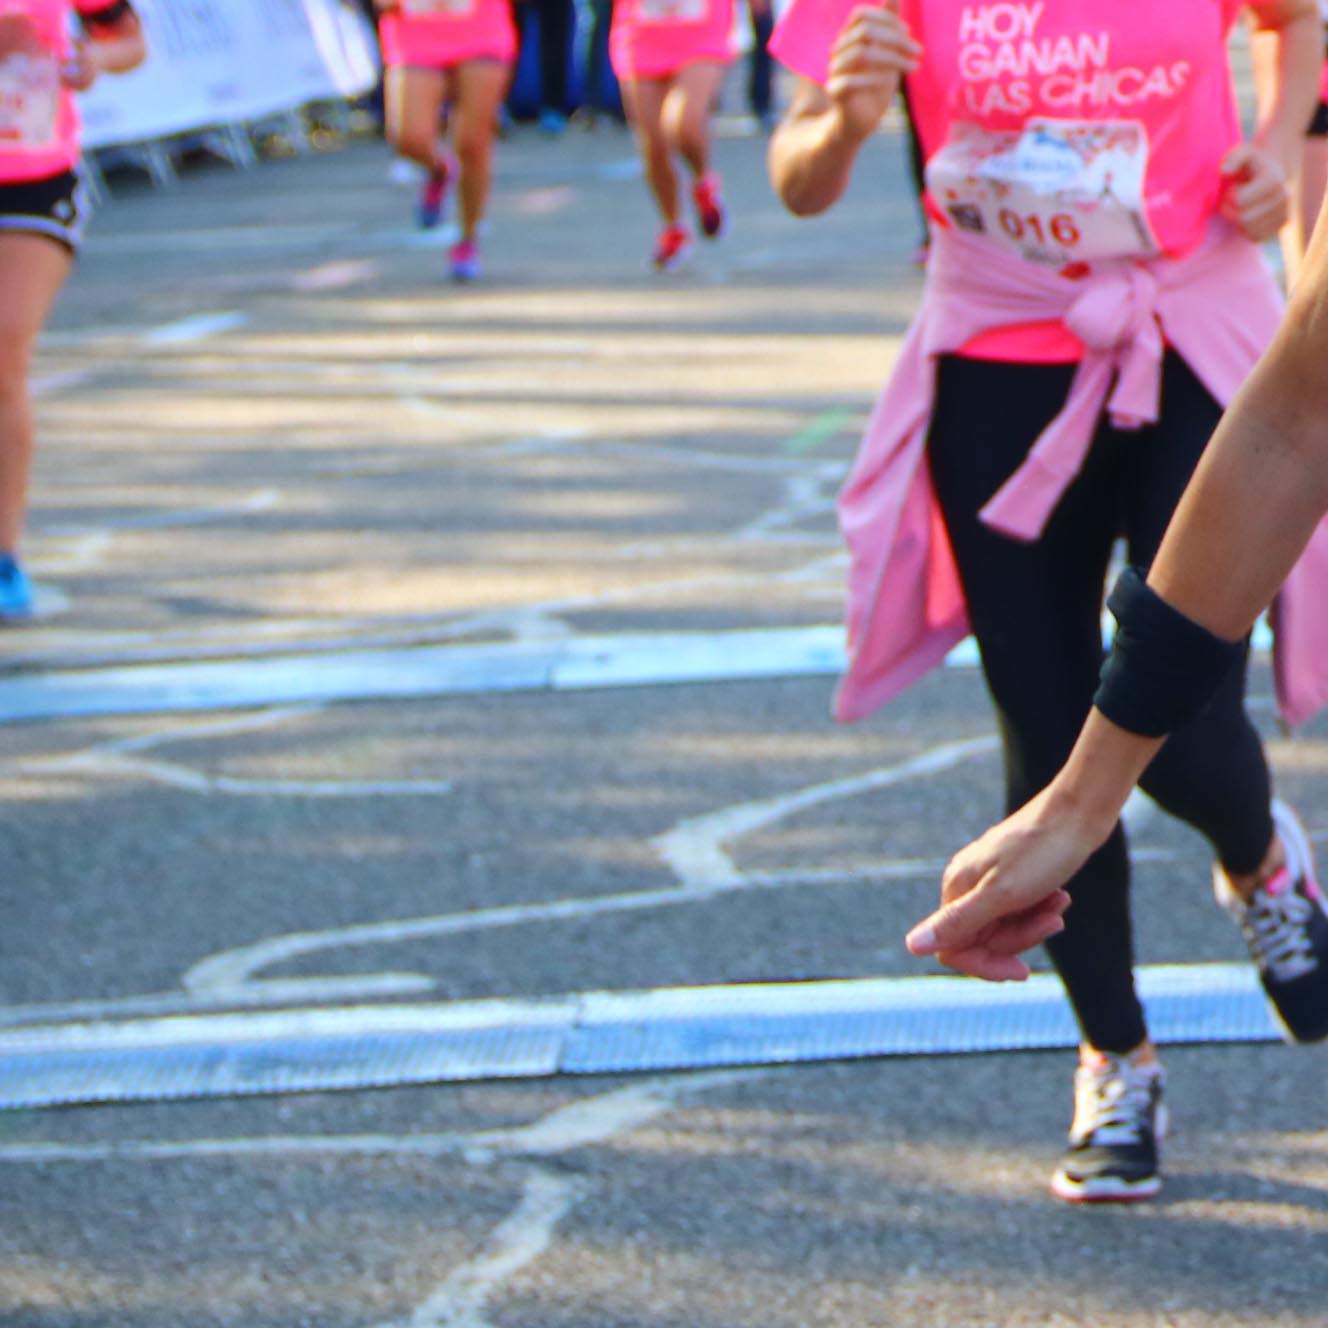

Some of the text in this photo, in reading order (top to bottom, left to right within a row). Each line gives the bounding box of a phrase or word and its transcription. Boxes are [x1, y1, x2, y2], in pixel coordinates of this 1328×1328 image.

[959, 0, 1045, 43] HOY
[959, 31, 1109, 81] GANAN
[964, 61, 1190, 115] LAS CHICAS
[998, 209, 1081, 246] 016
